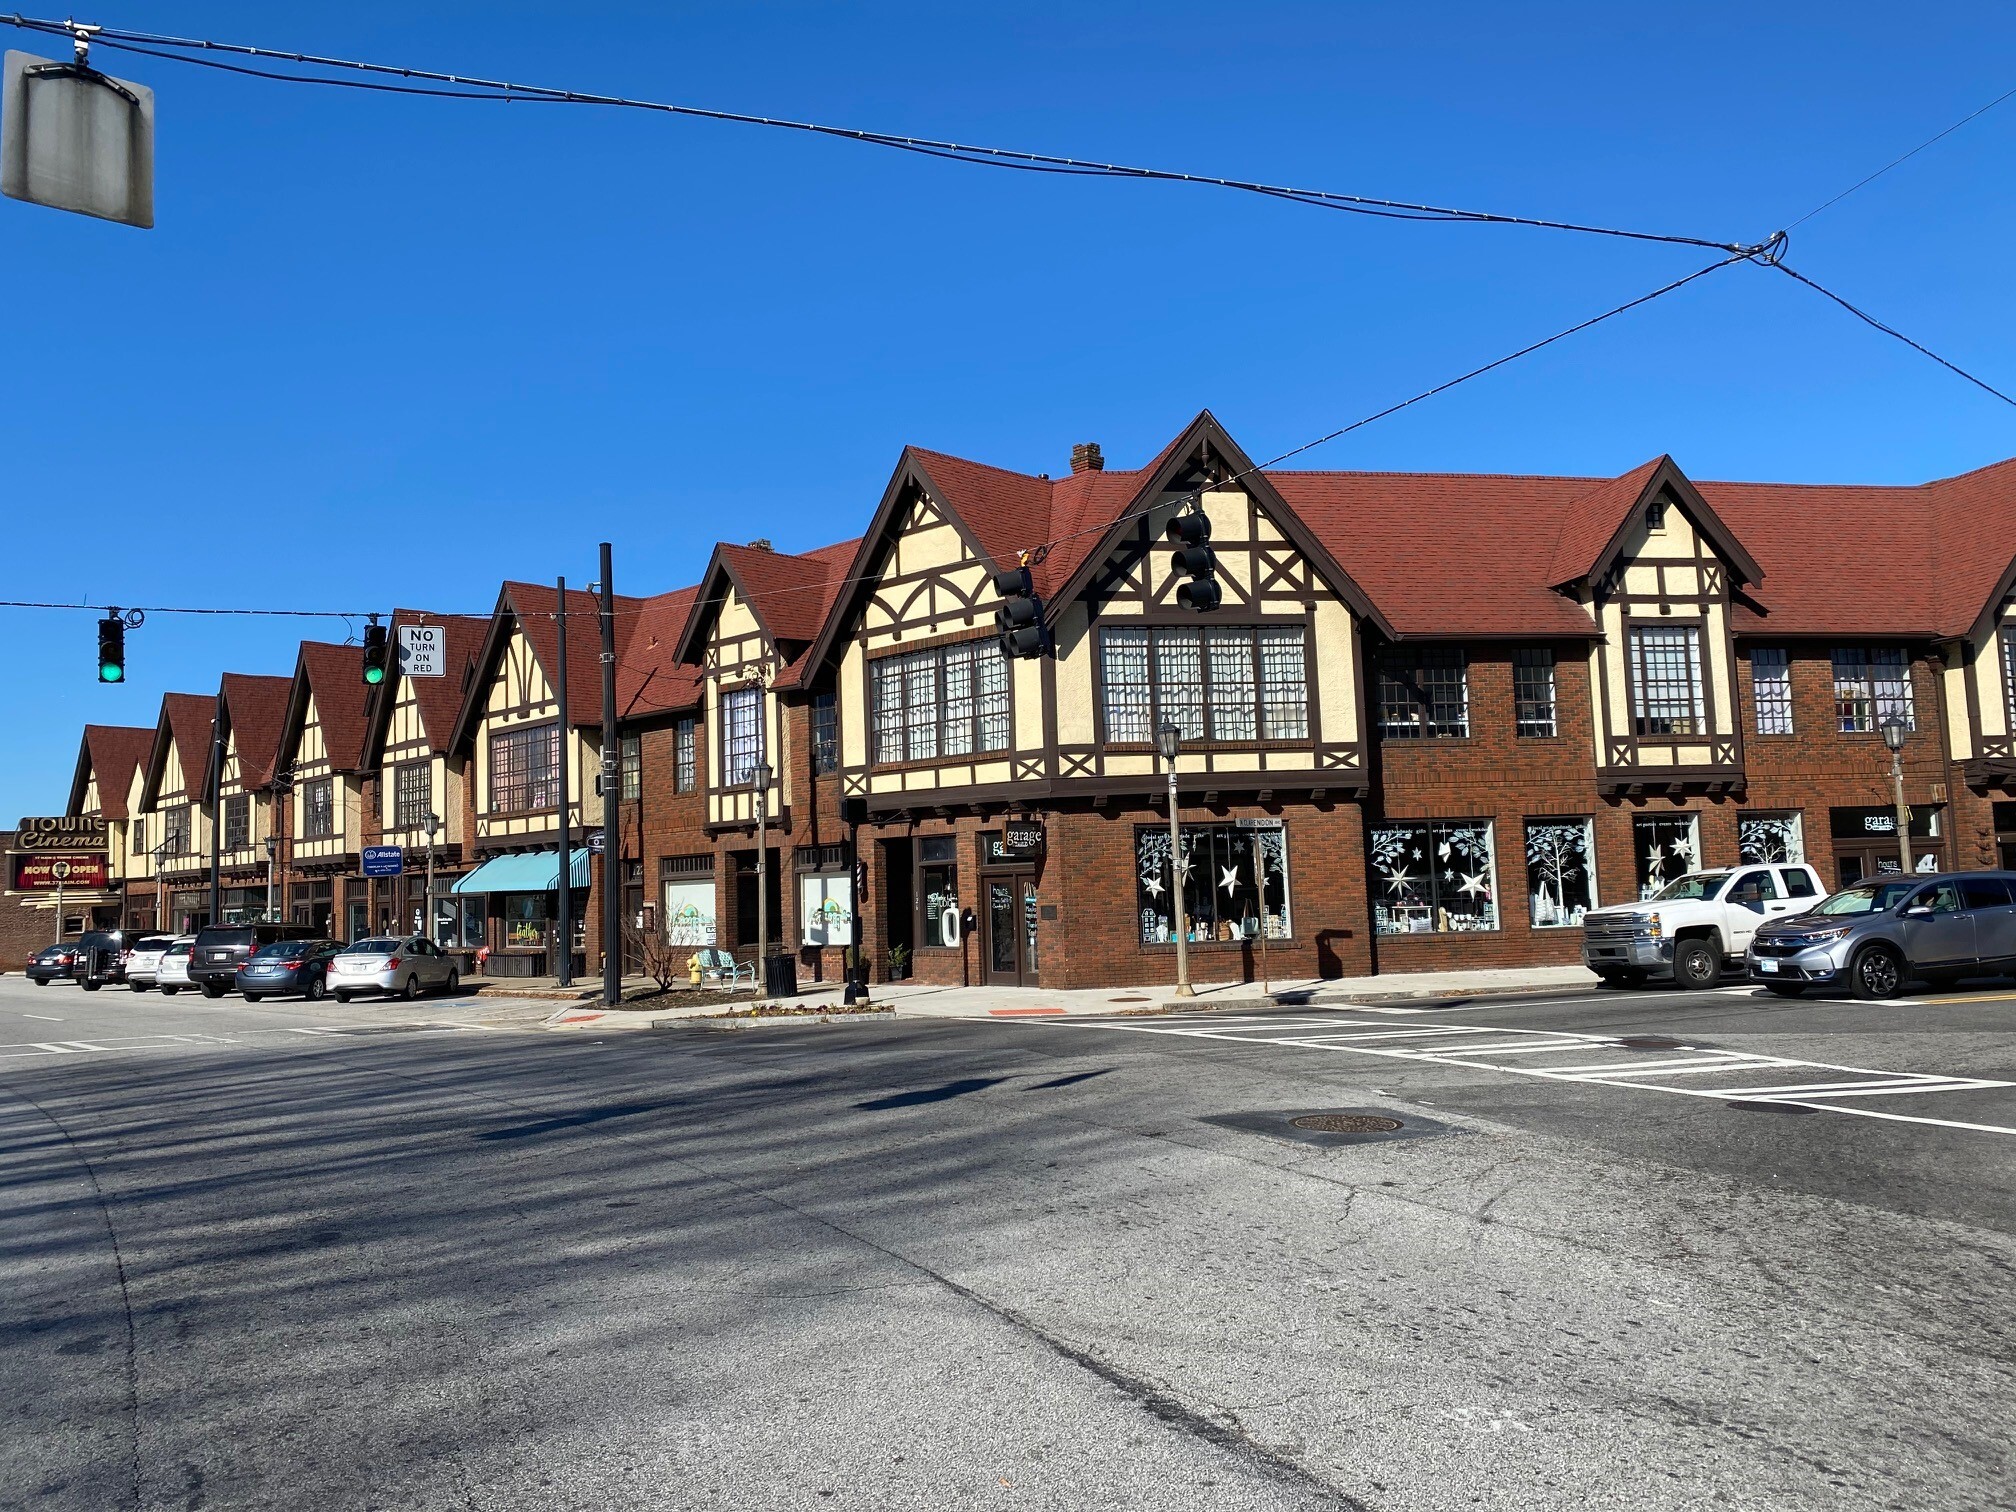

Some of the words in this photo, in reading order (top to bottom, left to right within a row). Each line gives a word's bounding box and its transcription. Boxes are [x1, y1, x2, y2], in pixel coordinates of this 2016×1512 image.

[410, 630, 434, 641] NO
[410, 643, 435, 652] TURN
[415, 654, 430, 662] ON
[413, 664, 432, 672] RED
[26, 817, 106, 832] TOWNE
[1864, 816, 1897, 830] garag
[19, 832, 105, 848] Cinema
[1007, 831, 1041, 846] garage
[1878, 857, 1898, 868] hours
[24, 866, 50, 874] NOW
[993, 885, 1008, 895] hours
[516, 921, 539, 941] feather
